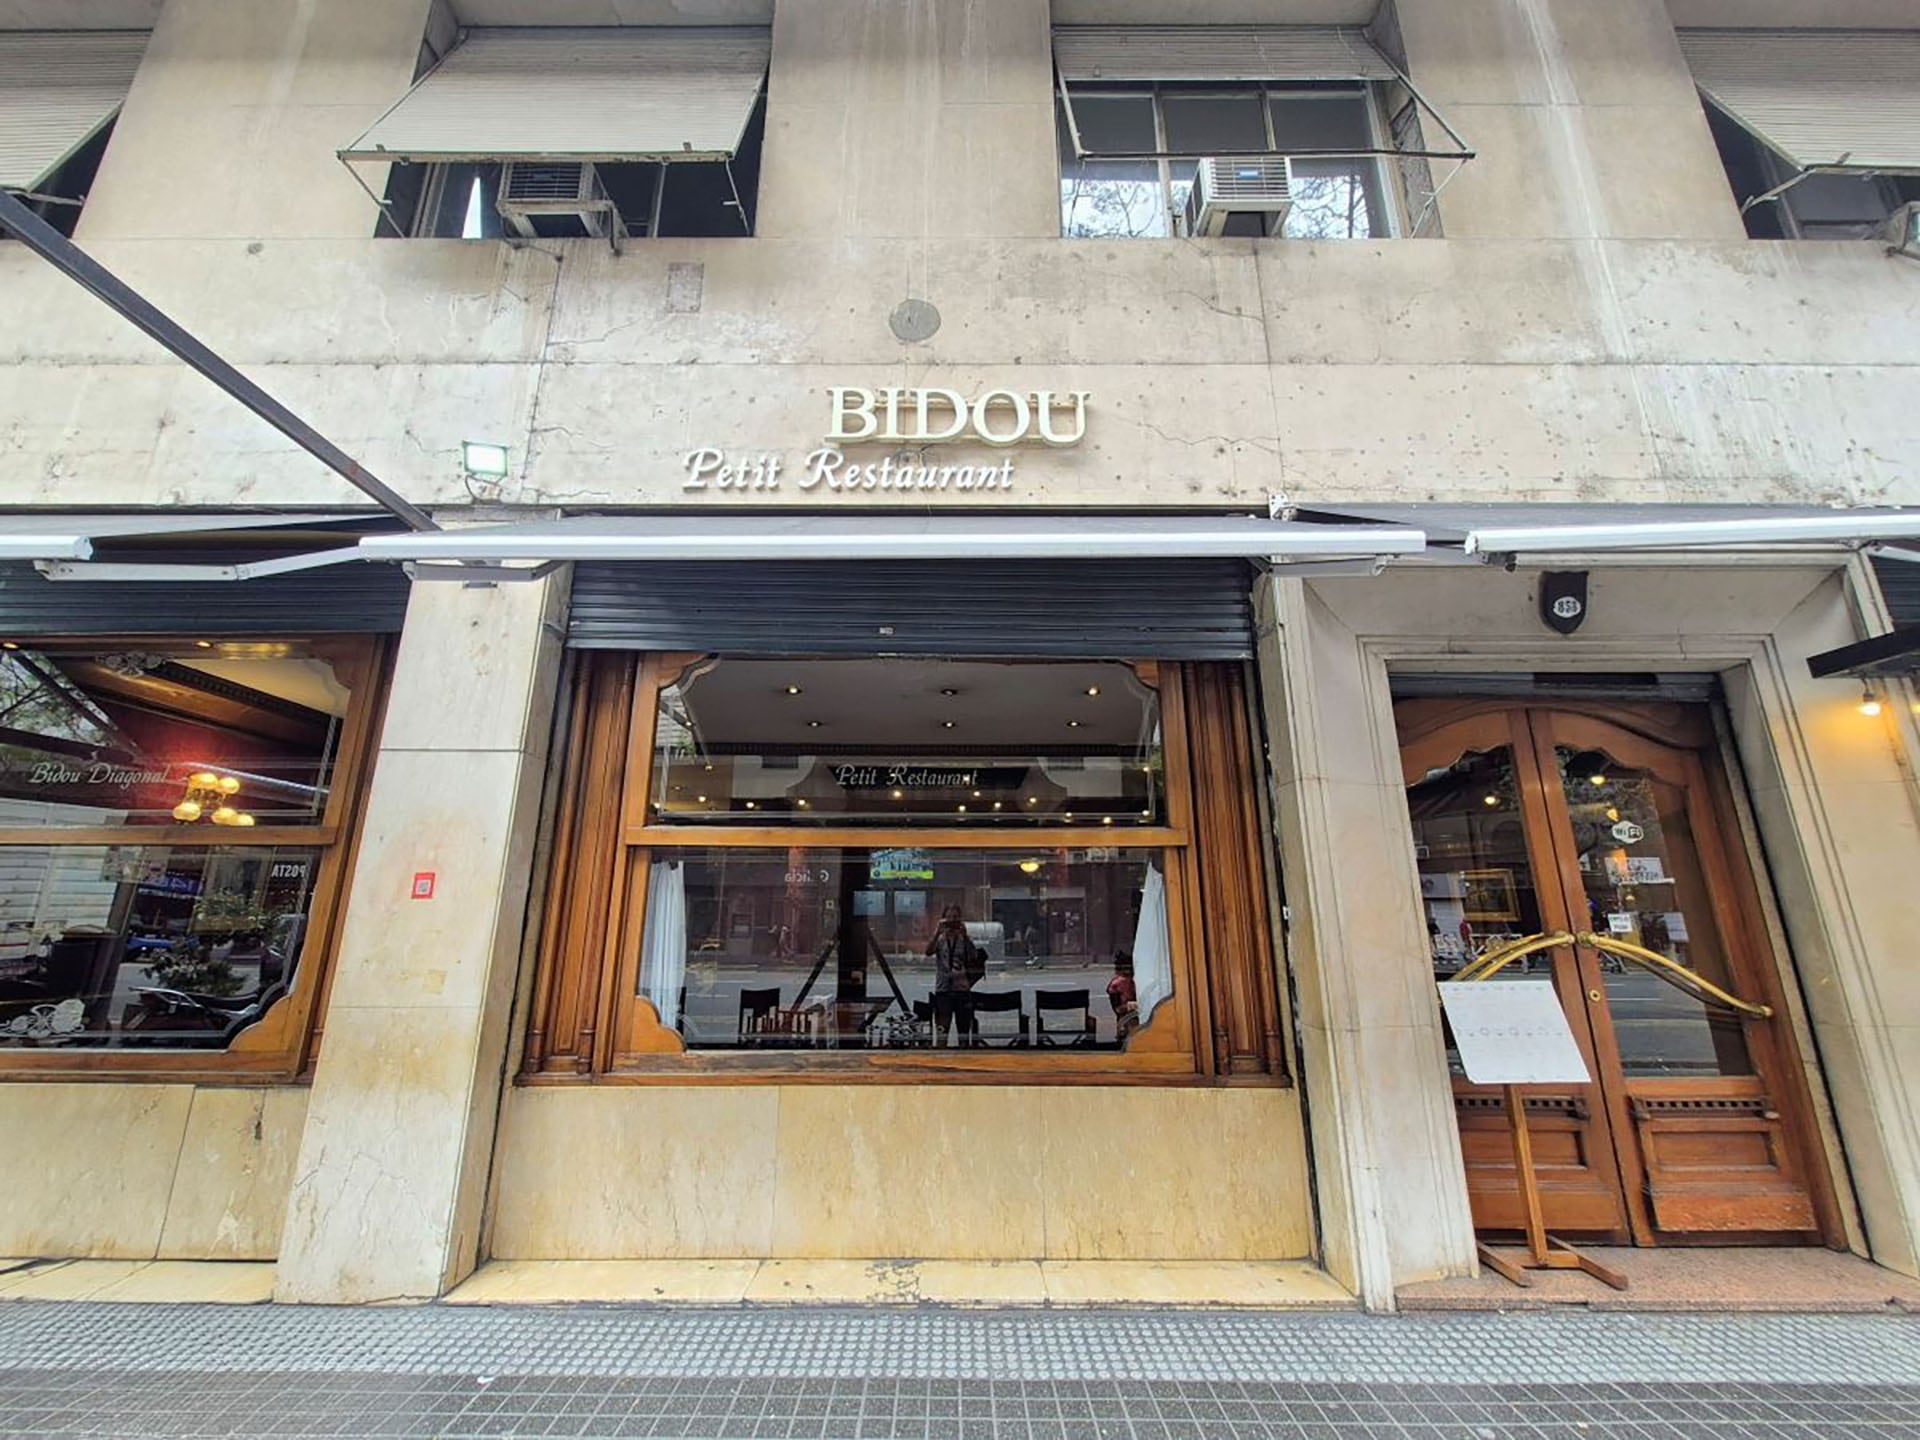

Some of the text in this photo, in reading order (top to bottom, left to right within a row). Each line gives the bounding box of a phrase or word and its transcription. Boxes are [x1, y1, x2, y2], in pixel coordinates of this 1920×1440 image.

[824, 387, 1090, 446] BIDOU
[682, 447, 1015, 492] Petit Restaurant
[28, 762, 170, 790] Bidou Diagonal
[835, 763, 978, 786] Petit Restaurant
